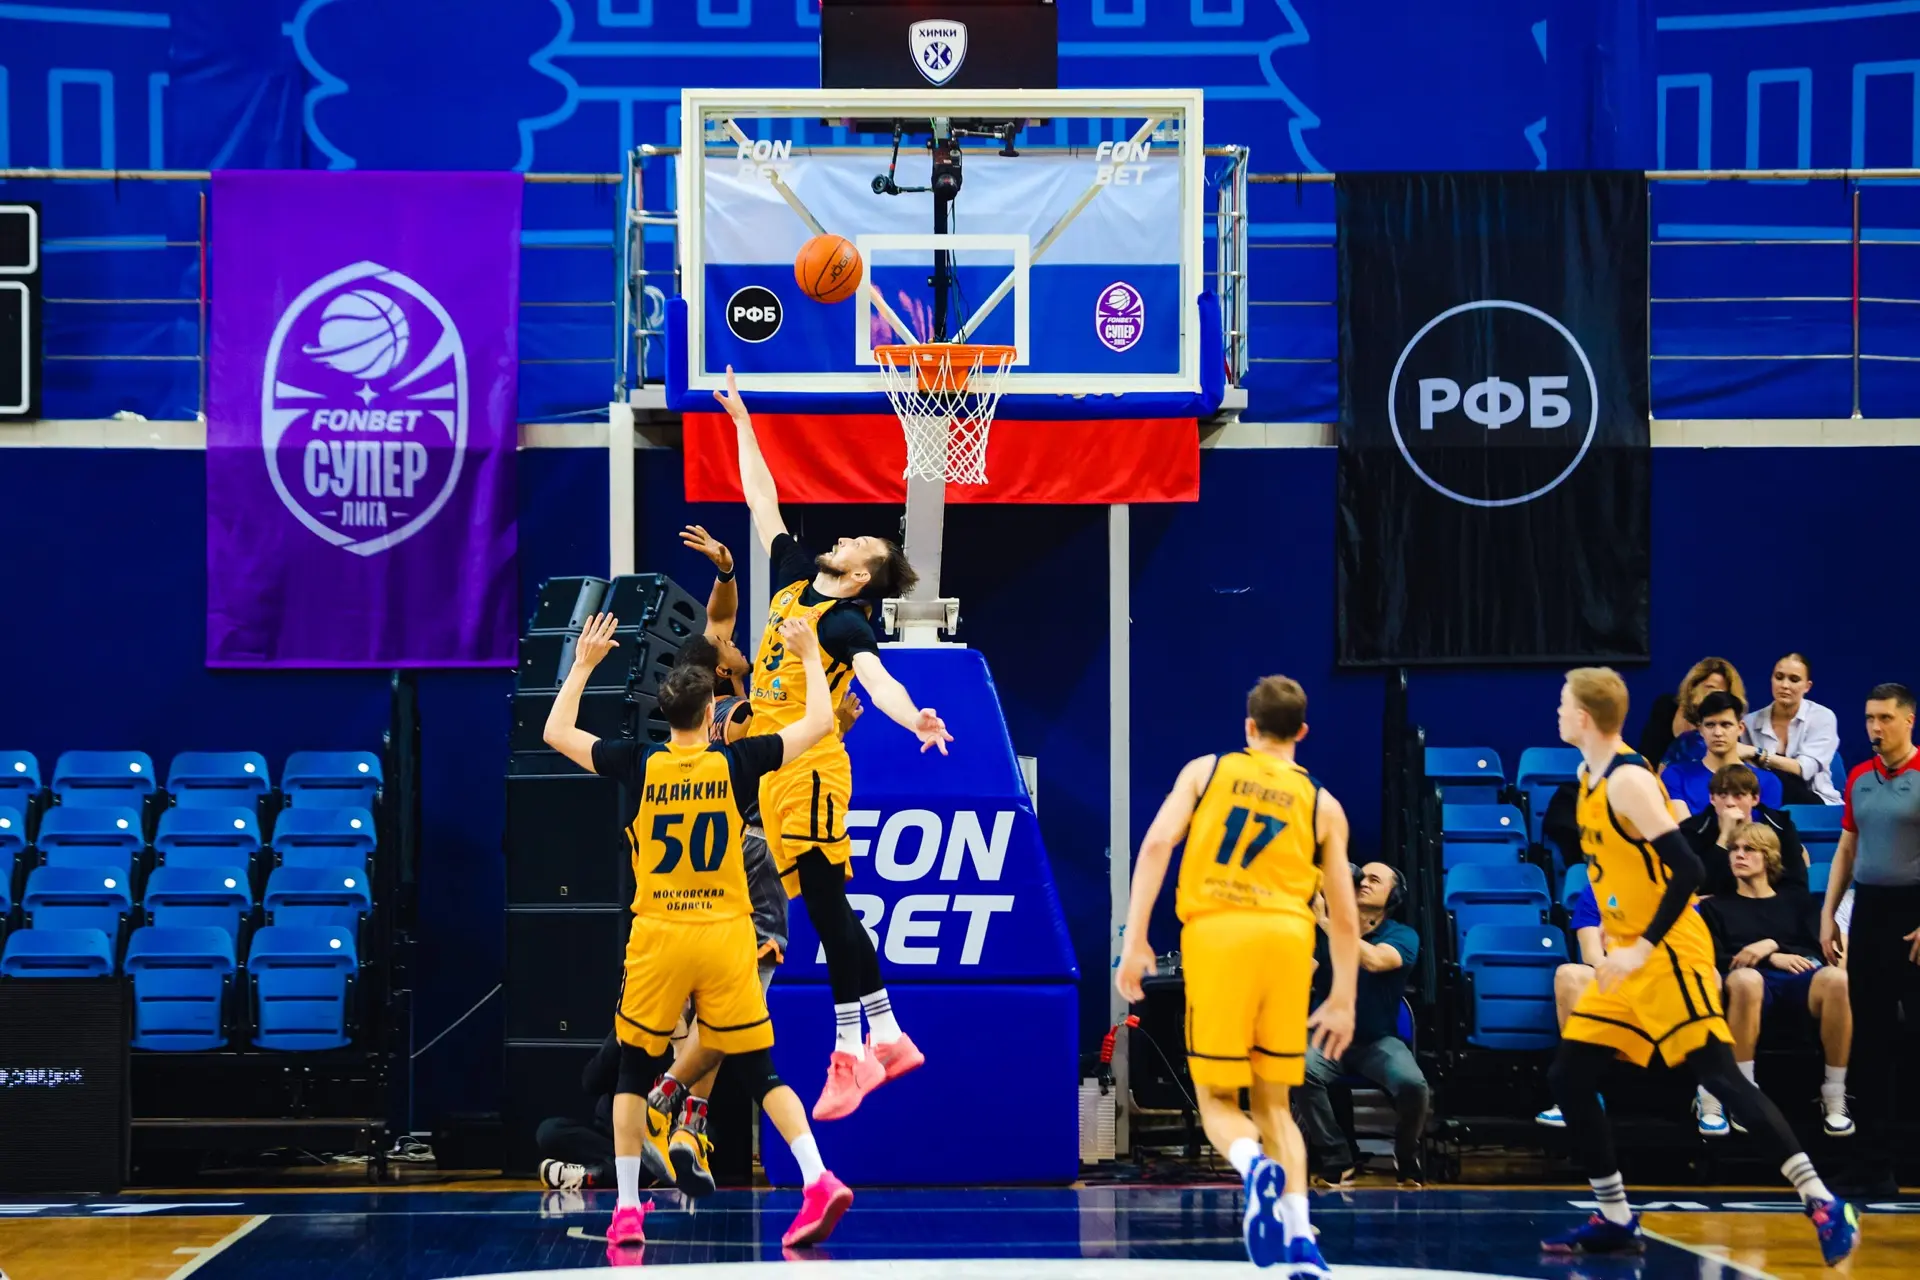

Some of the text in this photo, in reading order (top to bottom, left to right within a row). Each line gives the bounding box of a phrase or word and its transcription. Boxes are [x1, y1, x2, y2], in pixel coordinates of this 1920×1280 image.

[919, 28, 957, 38] ХИМКИ
[737, 139, 793, 161] FON
[1095, 140, 1151, 163] FON
[737, 163, 793, 185] BET
[1095, 165, 1151, 186] BET
[733, 306, 776, 323] РФБ
[1105, 324, 1135, 339] СУПЕР
[1418, 376, 1572, 430] РФБ
[311, 409, 424, 433] FONBET
[303, 439, 428, 498] СУПЕР
[341, 501, 388, 527] ЛИГА
[645, 778, 728, 806] АДАЙКИН
[650, 811, 729, 874] 50
[1215, 806, 1289, 870] 17
[653, 888, 725, 899] МОСКОВСКАЯ
[666, 901, 713, 911] ОБЛАСТЬ
